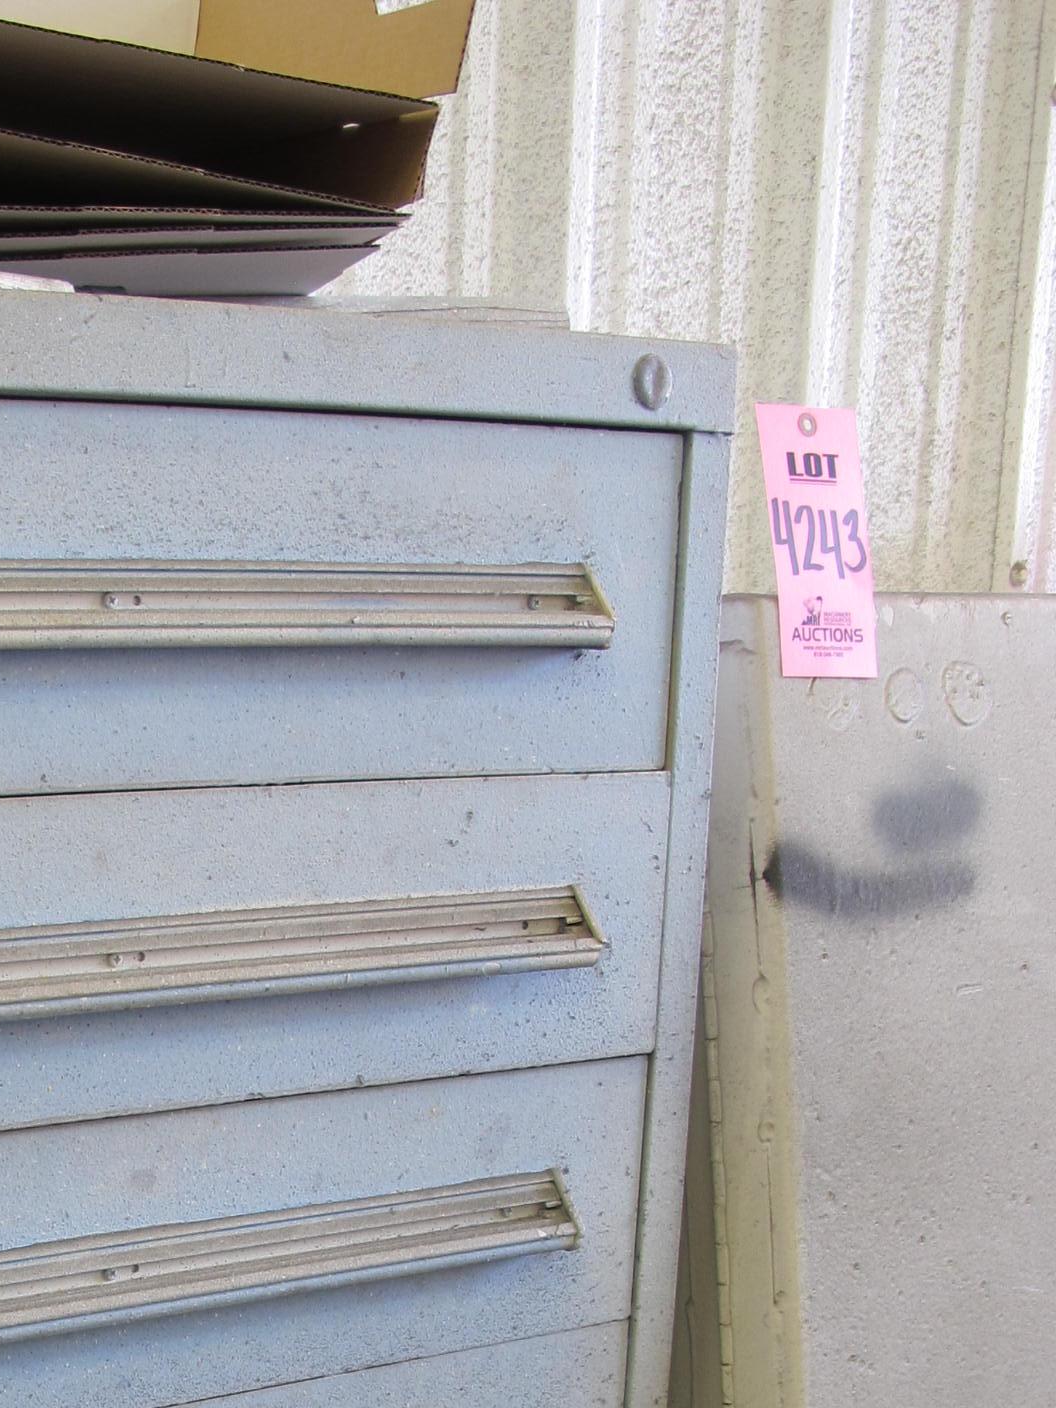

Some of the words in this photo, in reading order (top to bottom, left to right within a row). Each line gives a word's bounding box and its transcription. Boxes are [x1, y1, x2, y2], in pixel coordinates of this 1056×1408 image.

[786, 451, 839, 479] LOT
[771, 497, 868, 580] 4243
[792, 627, 864, 643] AUCTIONS
